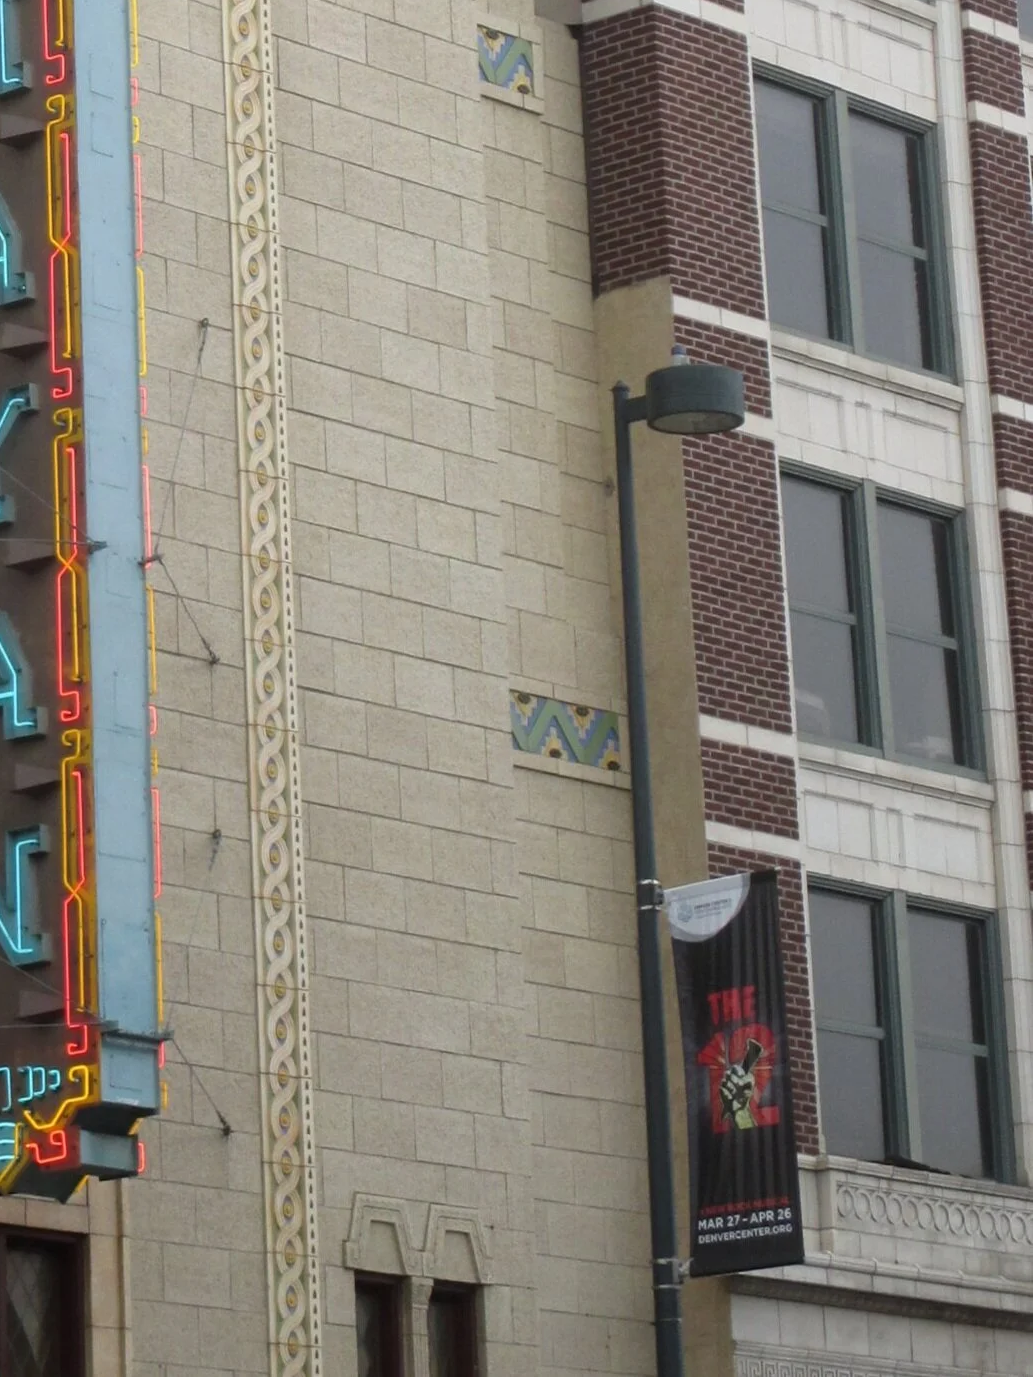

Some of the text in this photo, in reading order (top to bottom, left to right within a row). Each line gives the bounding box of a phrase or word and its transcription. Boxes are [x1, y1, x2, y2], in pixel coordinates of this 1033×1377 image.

[707, 984, 756, 1026] THE
[697, 1022, 780, 1134] 12
[698, 1216, 724, 1230] MAR
[727, 1214, 741, 1227] 27
[749, 1210, 775, 1224] APR
[777, 1207, 792, 1220] 26
[698, 1223, 793, 1244] DENVERCENTER.ORG
